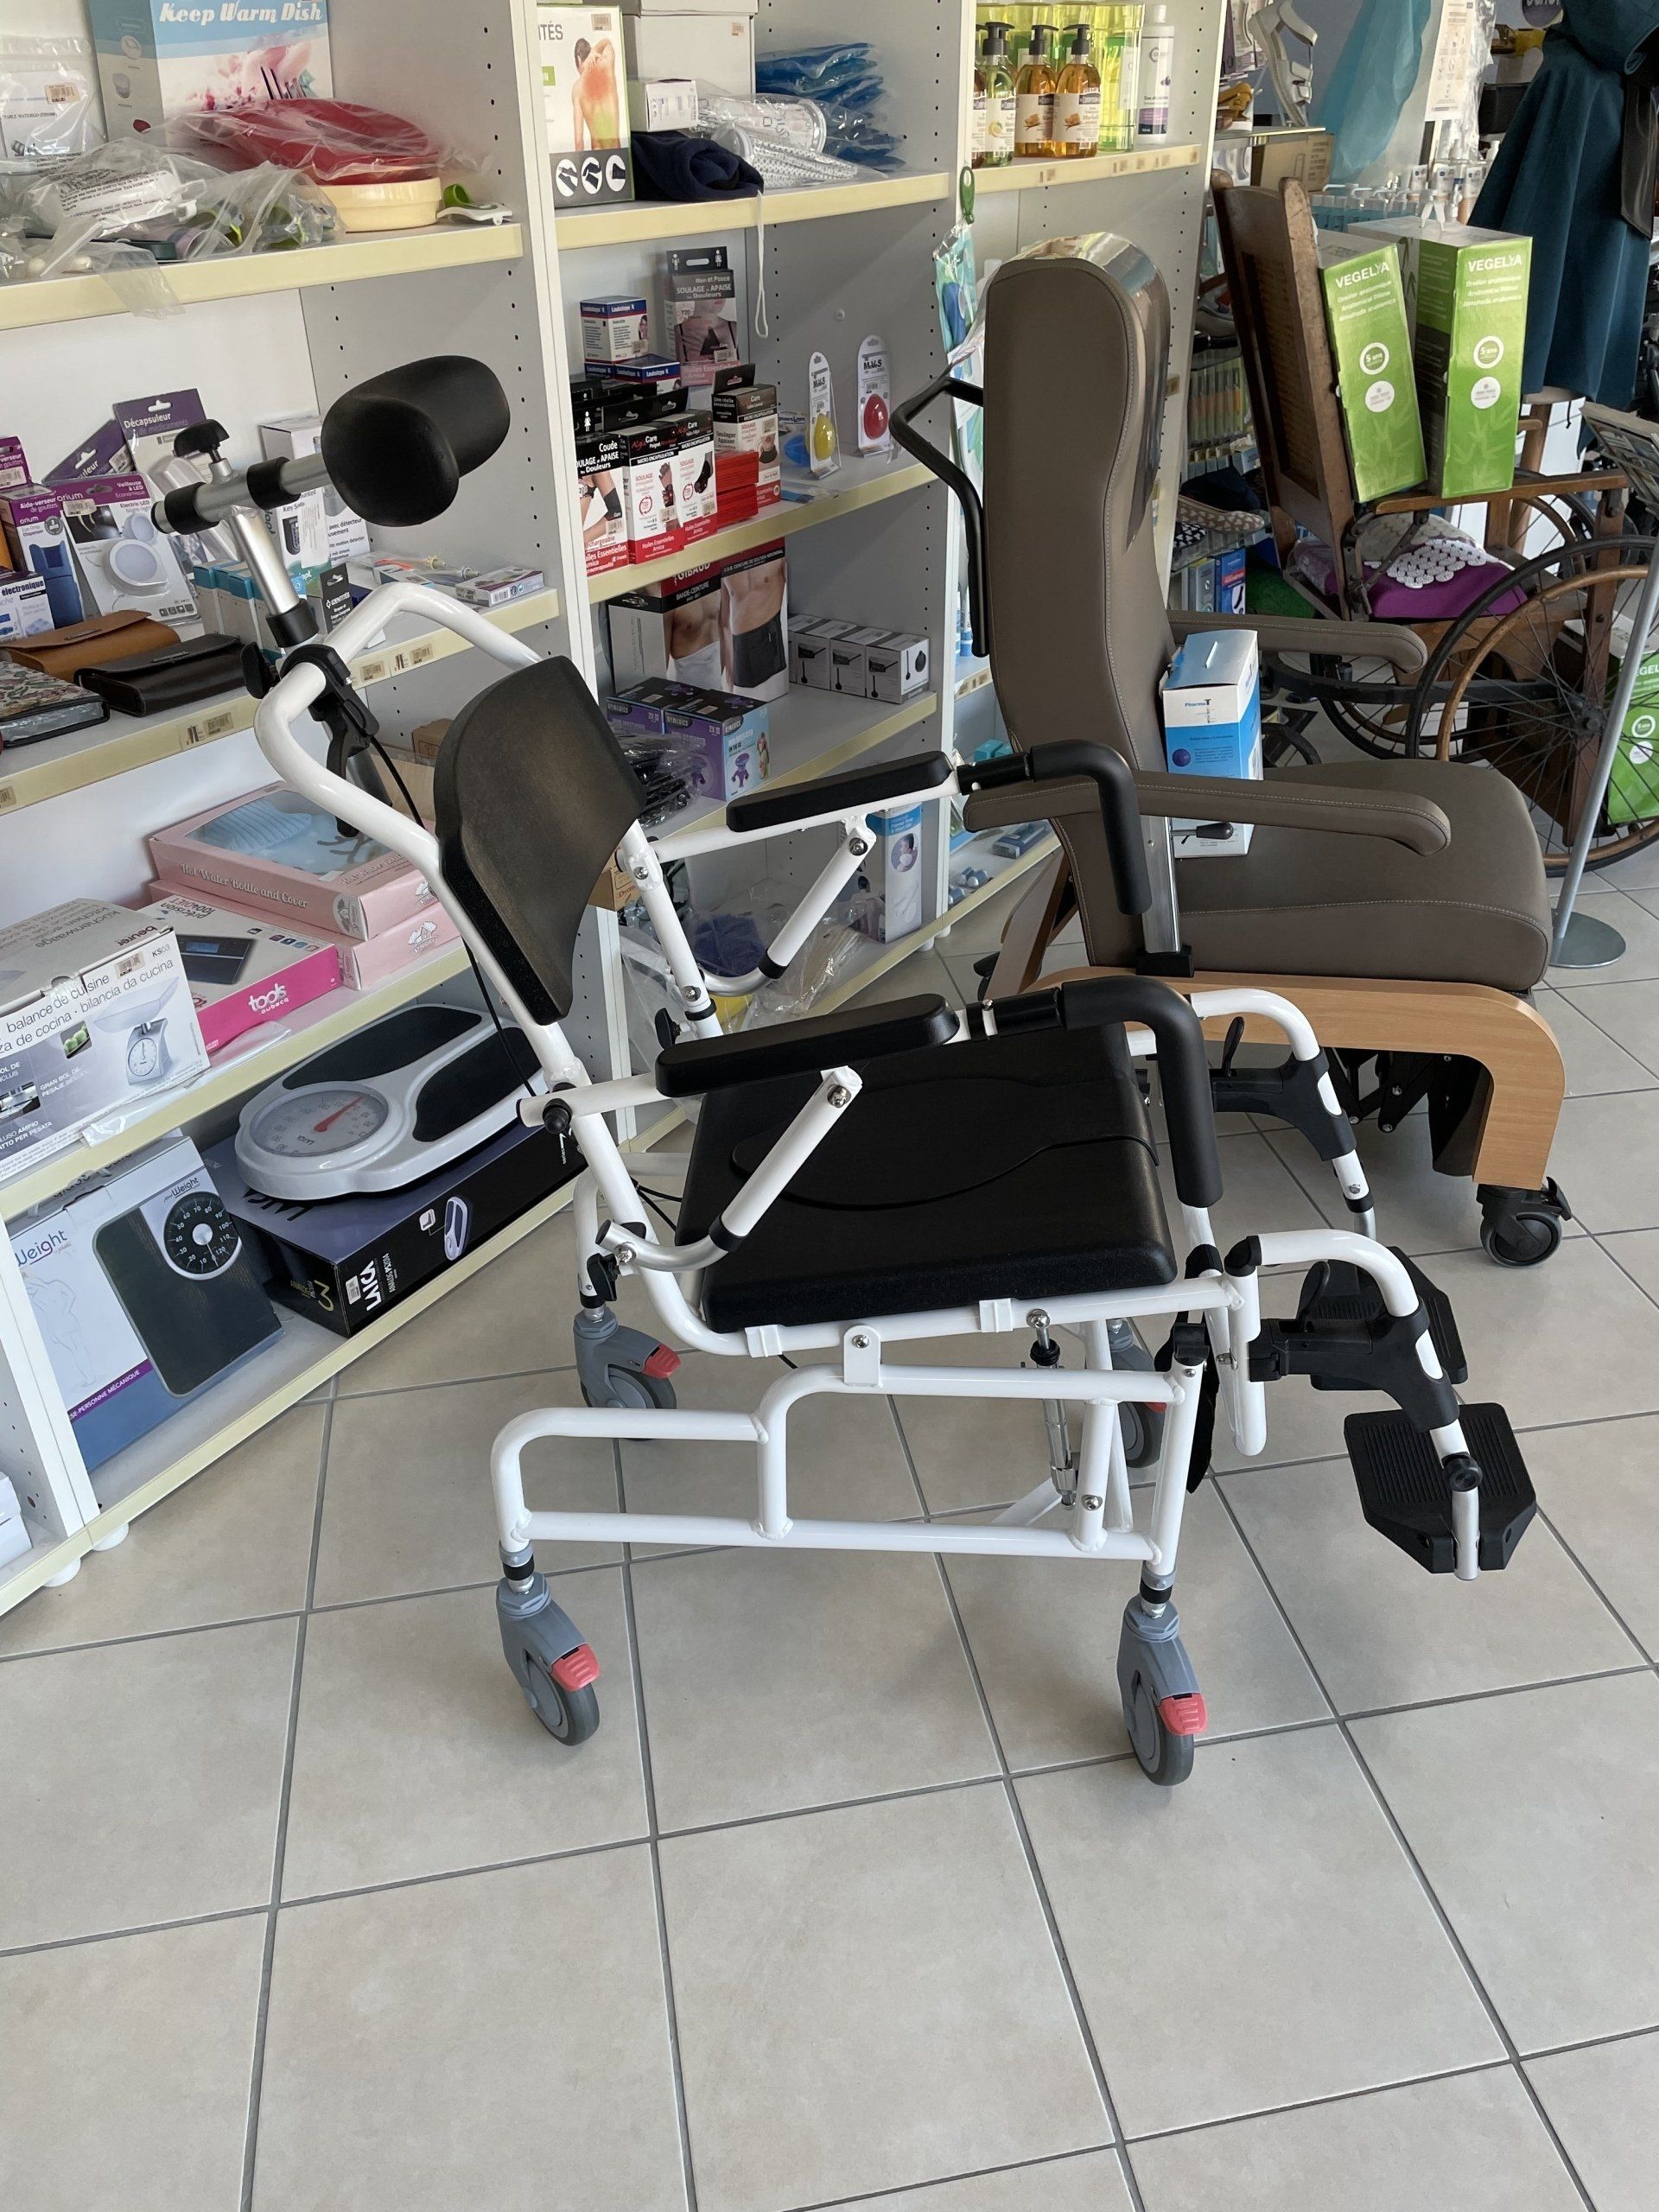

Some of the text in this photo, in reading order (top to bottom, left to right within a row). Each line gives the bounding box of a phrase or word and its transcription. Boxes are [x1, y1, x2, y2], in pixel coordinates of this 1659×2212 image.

[159, 3, 323, 25] Keep Warm Dish
[1468, 254, 1522, 273] VEGELYA
[1335, 262, 1389, 288] VEGELYA
[124, 413, 171, 429] Décapsuleur
[687, 421, 698, 429] Care
[599, 441, 618, 452] Coude
[601, 451, 619, 462] APAISE
[586, 462, 611, 474] Douleurs
[57, 493, 84, 501] orium
[19, 516, 39, 524] orium
[597, 544, 626, 557] Essentielles
[2, 580, 44, 596] électronique
[181, 863, 308, 909] Hot Water Bottle and Cover
[161, 902, 207, 919] précision
[117, 925, 158, 947] beurer
[151, 944, 171, 958] KS03
[6, 974, 111, 1033] balance de cuisine
[16, 1030, 33, 1047] de
[35, 1013, 73, 1038] cocina
[80, 986, 121, 1012] bilancia
[124, 977, 138, 991] da
[139, 959, 174, 982] cucina
[248, 982, 287, 1012] tools
[261, 997, 289, 1014] aubecq
[40, 1078, 58, 1090] GRAN
[58, 1071, 71, 1081] BOL
[41, 1083, 65, 1097] PESAJE
[15, 1133, 29, 1143] PER
[29, 1122, 53, 1136] PESATA
[18, 1120, 39, 1134] AMPIO
[171, 1177, 199, 1196] Weight
[219, 1222, 229, 1230] 100
[219, 1234, 230, 1243] 110
[215, 1246, 226, 1255] 120
[360, 1261, 382, 1311] LAICA
[385, 1271, 397, 1294] ANALOG
[107, 1369, 140, 1394] MÉCANIQUE
